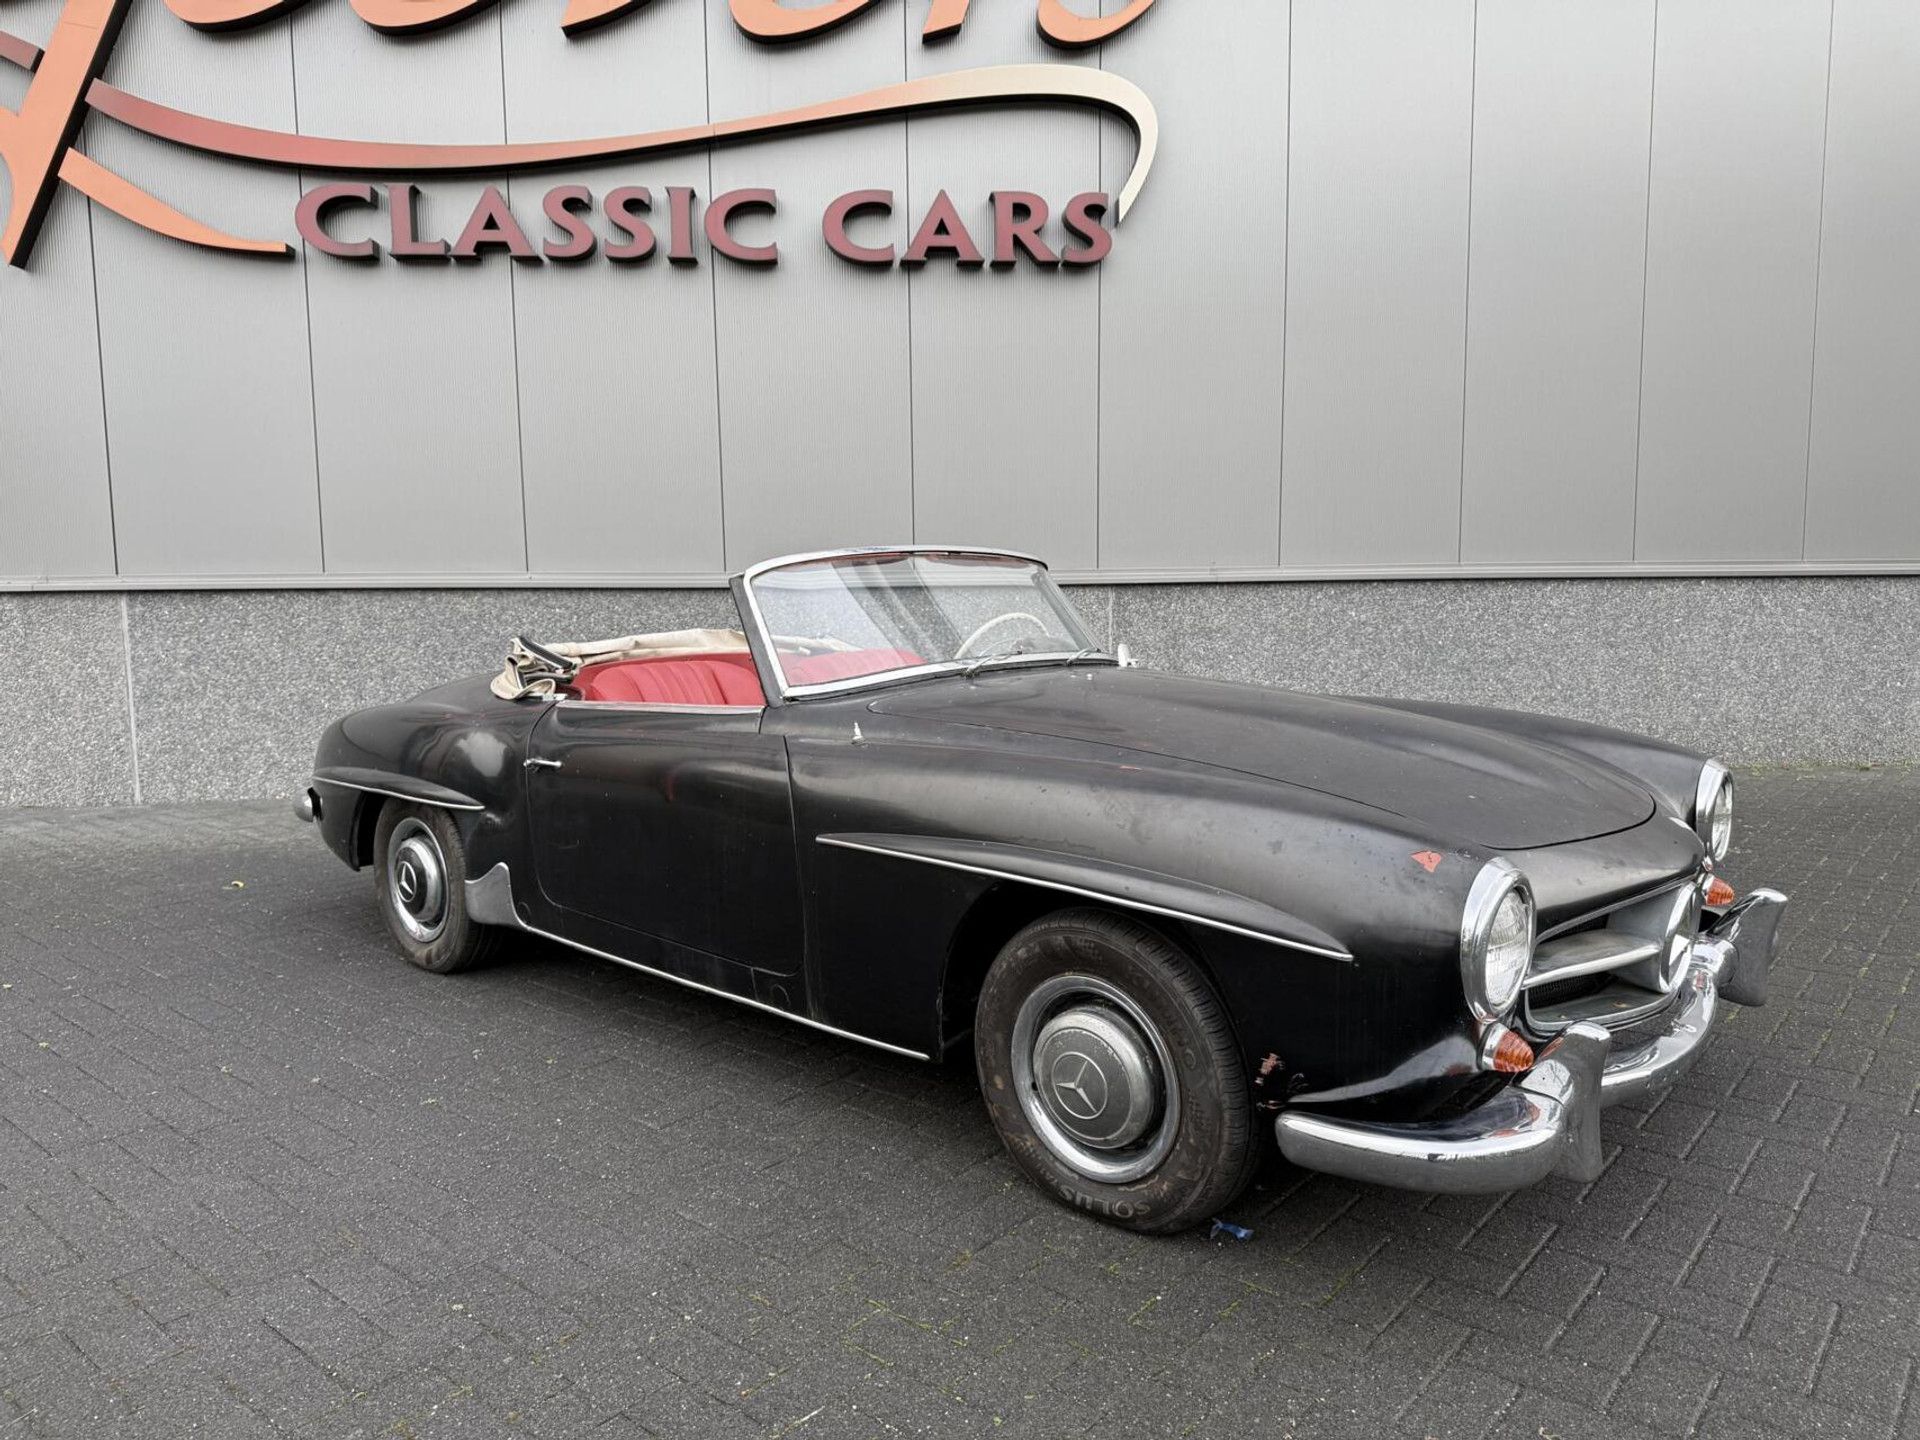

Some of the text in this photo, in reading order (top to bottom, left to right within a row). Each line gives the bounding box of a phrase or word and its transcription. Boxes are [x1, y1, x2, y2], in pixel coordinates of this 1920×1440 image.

[295, 184, 1113, 269] CLASSIC CARS
[1059, 1186, 1151, 1218] SOLUS
